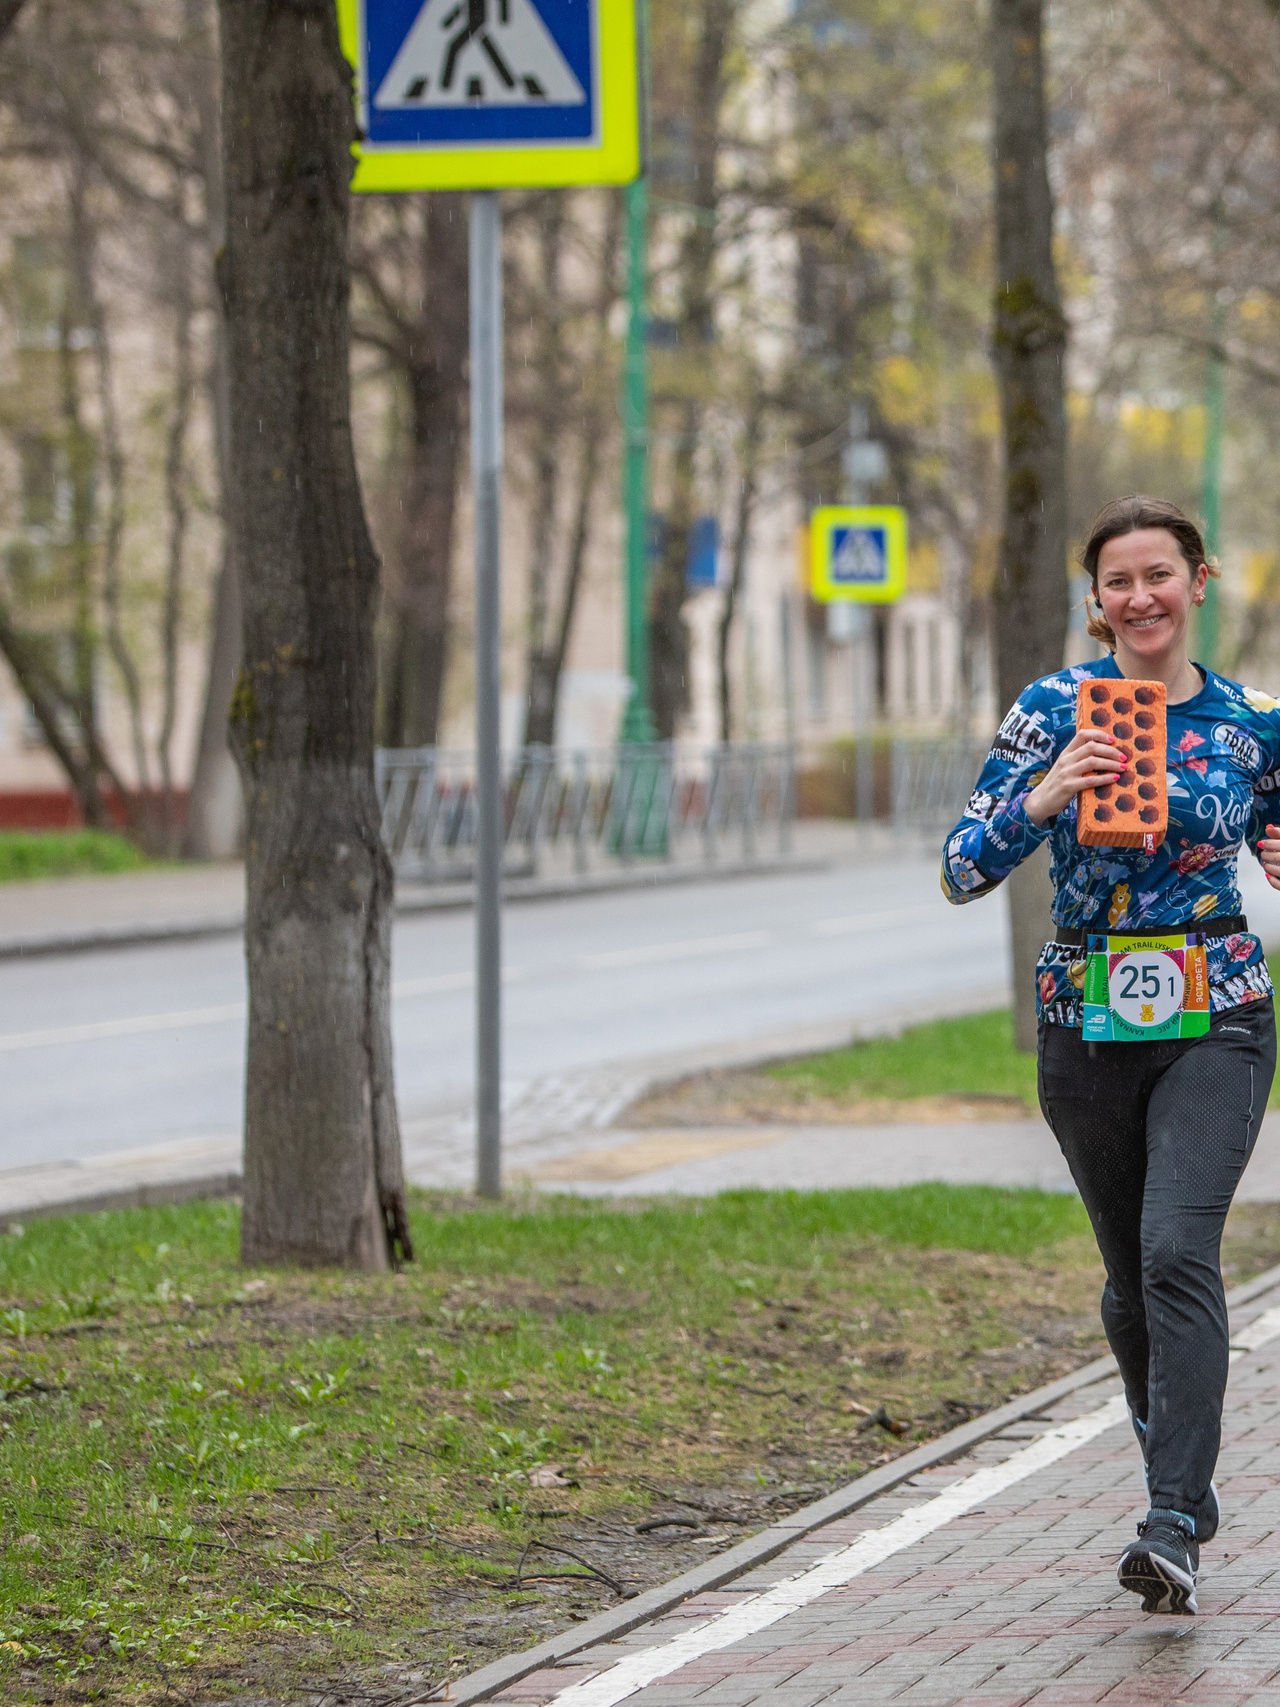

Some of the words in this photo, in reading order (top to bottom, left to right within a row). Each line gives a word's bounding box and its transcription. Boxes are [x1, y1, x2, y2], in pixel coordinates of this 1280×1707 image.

[987, 747, 1033, 766] ТОЗНАТЬ
[1195, 791, 1252, 841] Kan
[1110, 945, 1132, 967] DREAM
[1132, 941, 1154, 949] TRAIL
[1154, 942, 1182, 962] LYSKOVO
[1101, 976, 1110, 997] TRAIL
[1194, 956, 1204, 1003] ЭСТАФЕТА
[1114, 1018, 1145, 1036] KANNAS
[1157, 1022, 1171, 1034] ЛЕС
